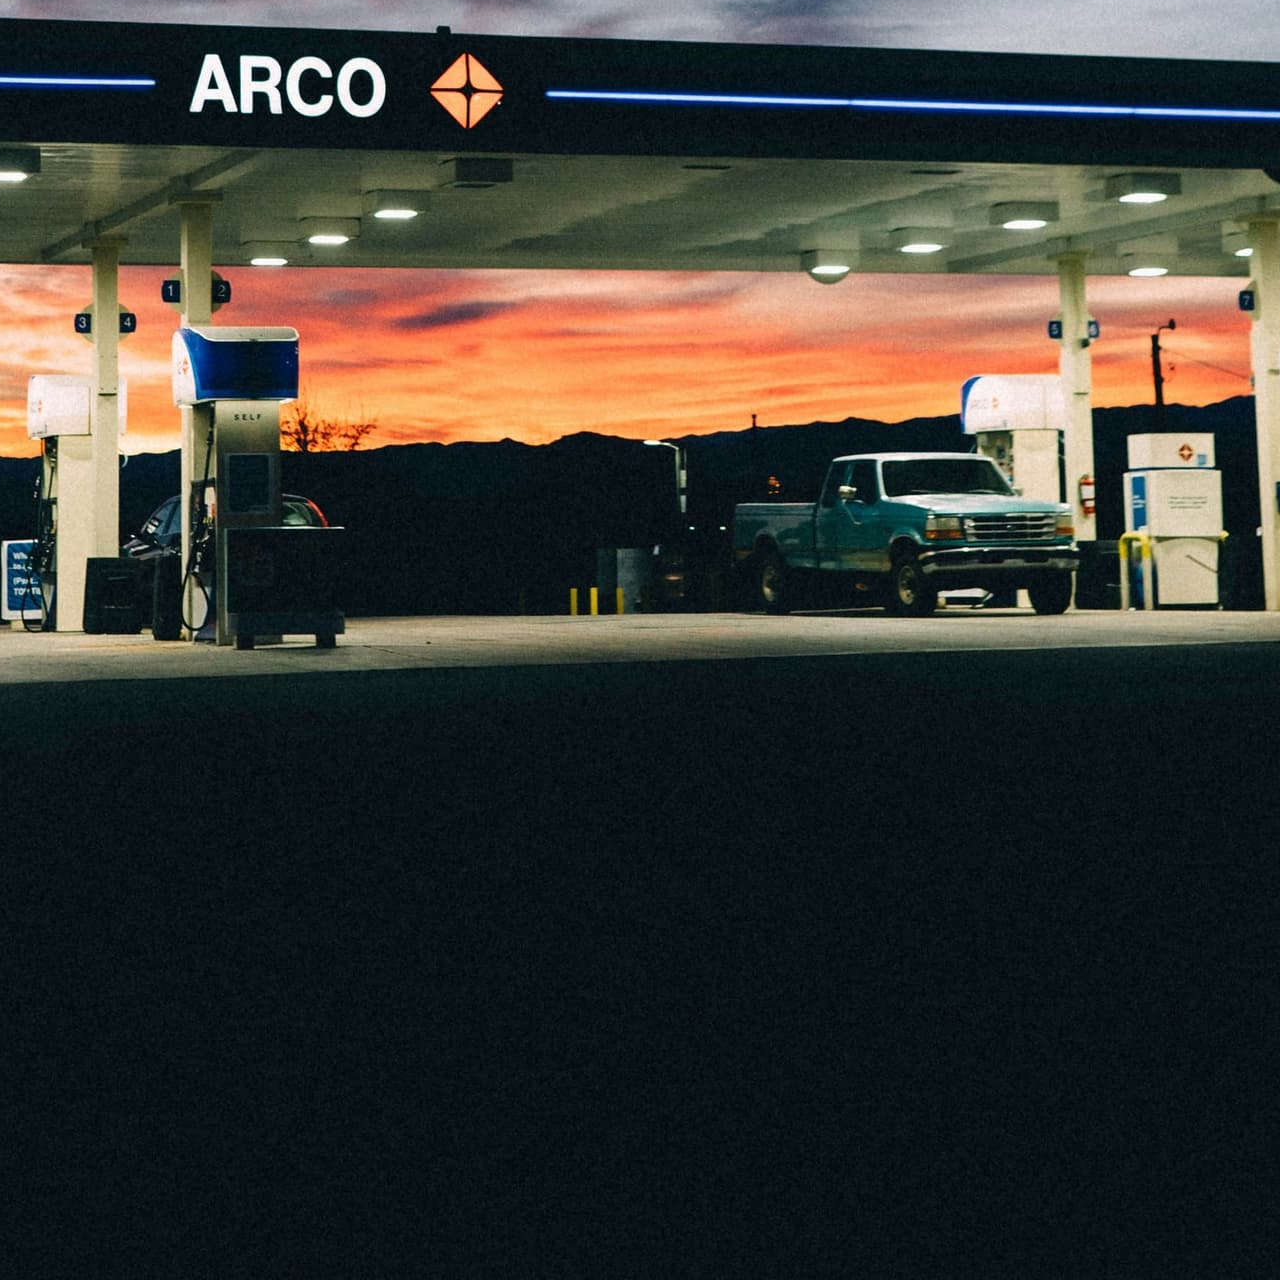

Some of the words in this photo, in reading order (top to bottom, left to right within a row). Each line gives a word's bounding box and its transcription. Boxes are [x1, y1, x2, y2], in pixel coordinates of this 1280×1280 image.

[189, 53, 387, 118] ARCO
[167, 284, 174, 297] 1
[217, 285, 226, 297] 2
[78, 316, 87, 329] 3
[123, 316, 131, 328] 4
